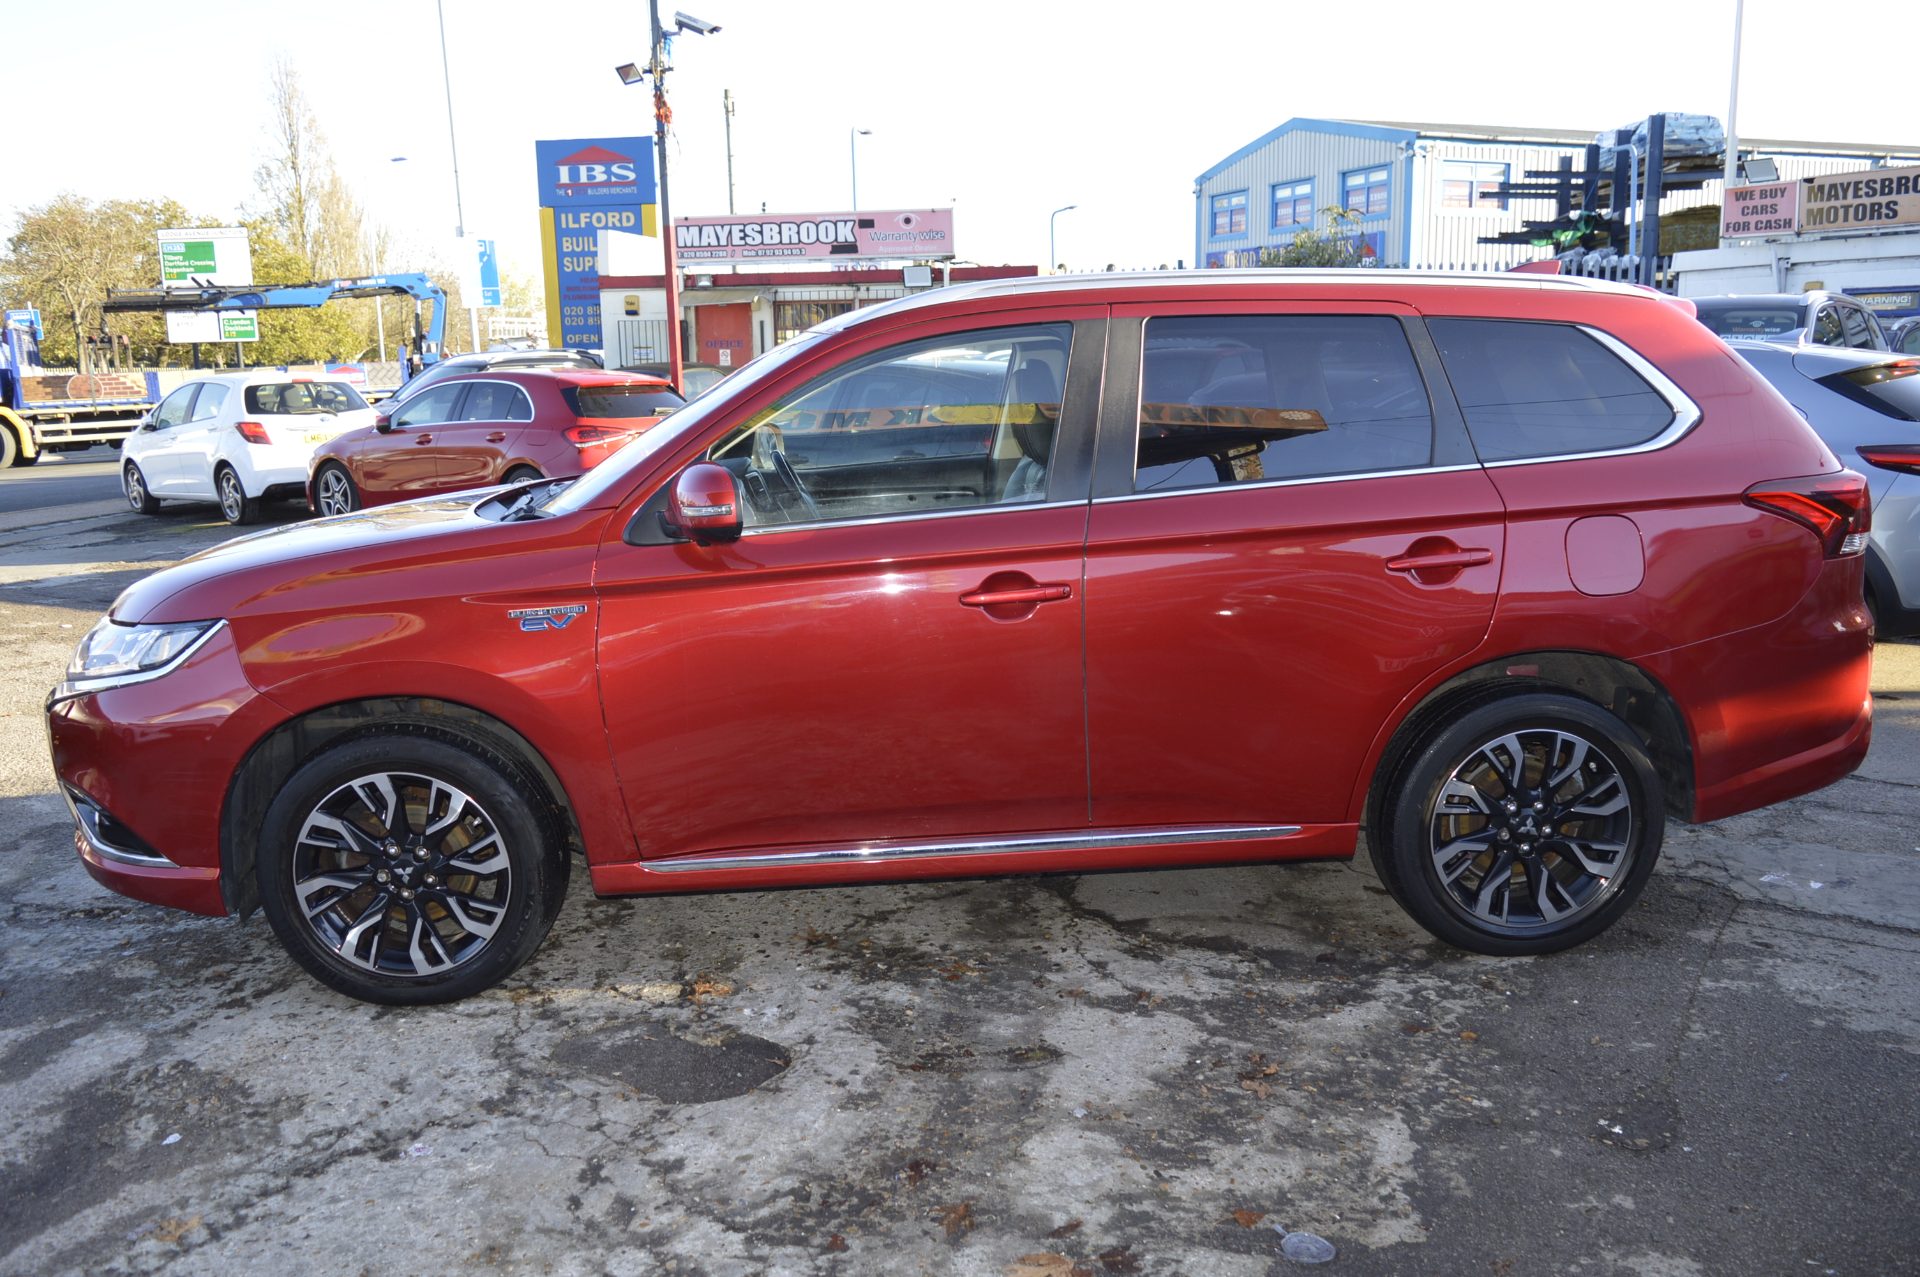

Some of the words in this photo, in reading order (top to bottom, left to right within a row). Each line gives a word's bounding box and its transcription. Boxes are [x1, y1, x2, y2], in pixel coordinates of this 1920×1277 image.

[556, 163, 636, 184] IBS
[1734, 190, 1756, 202] WE
[1759, 187, 1787, 200] BUY
[1741, 203, 1778, 217] CARS
[1806, 200, 1898, 226] MOTORS
[561, 212, 635, 228] ILFORD
[1725, 221, 1750, 232] FOR
[1755, 218, 1792, 230] CASH
[676, 220, 856, 248] MAYESBROOK
[564, 306, 584, 315] 020
[565, 316, 584, 326] 020
[567, 334, 598, 344] OPEN
[705, 339, 744, 349] OFFICE
